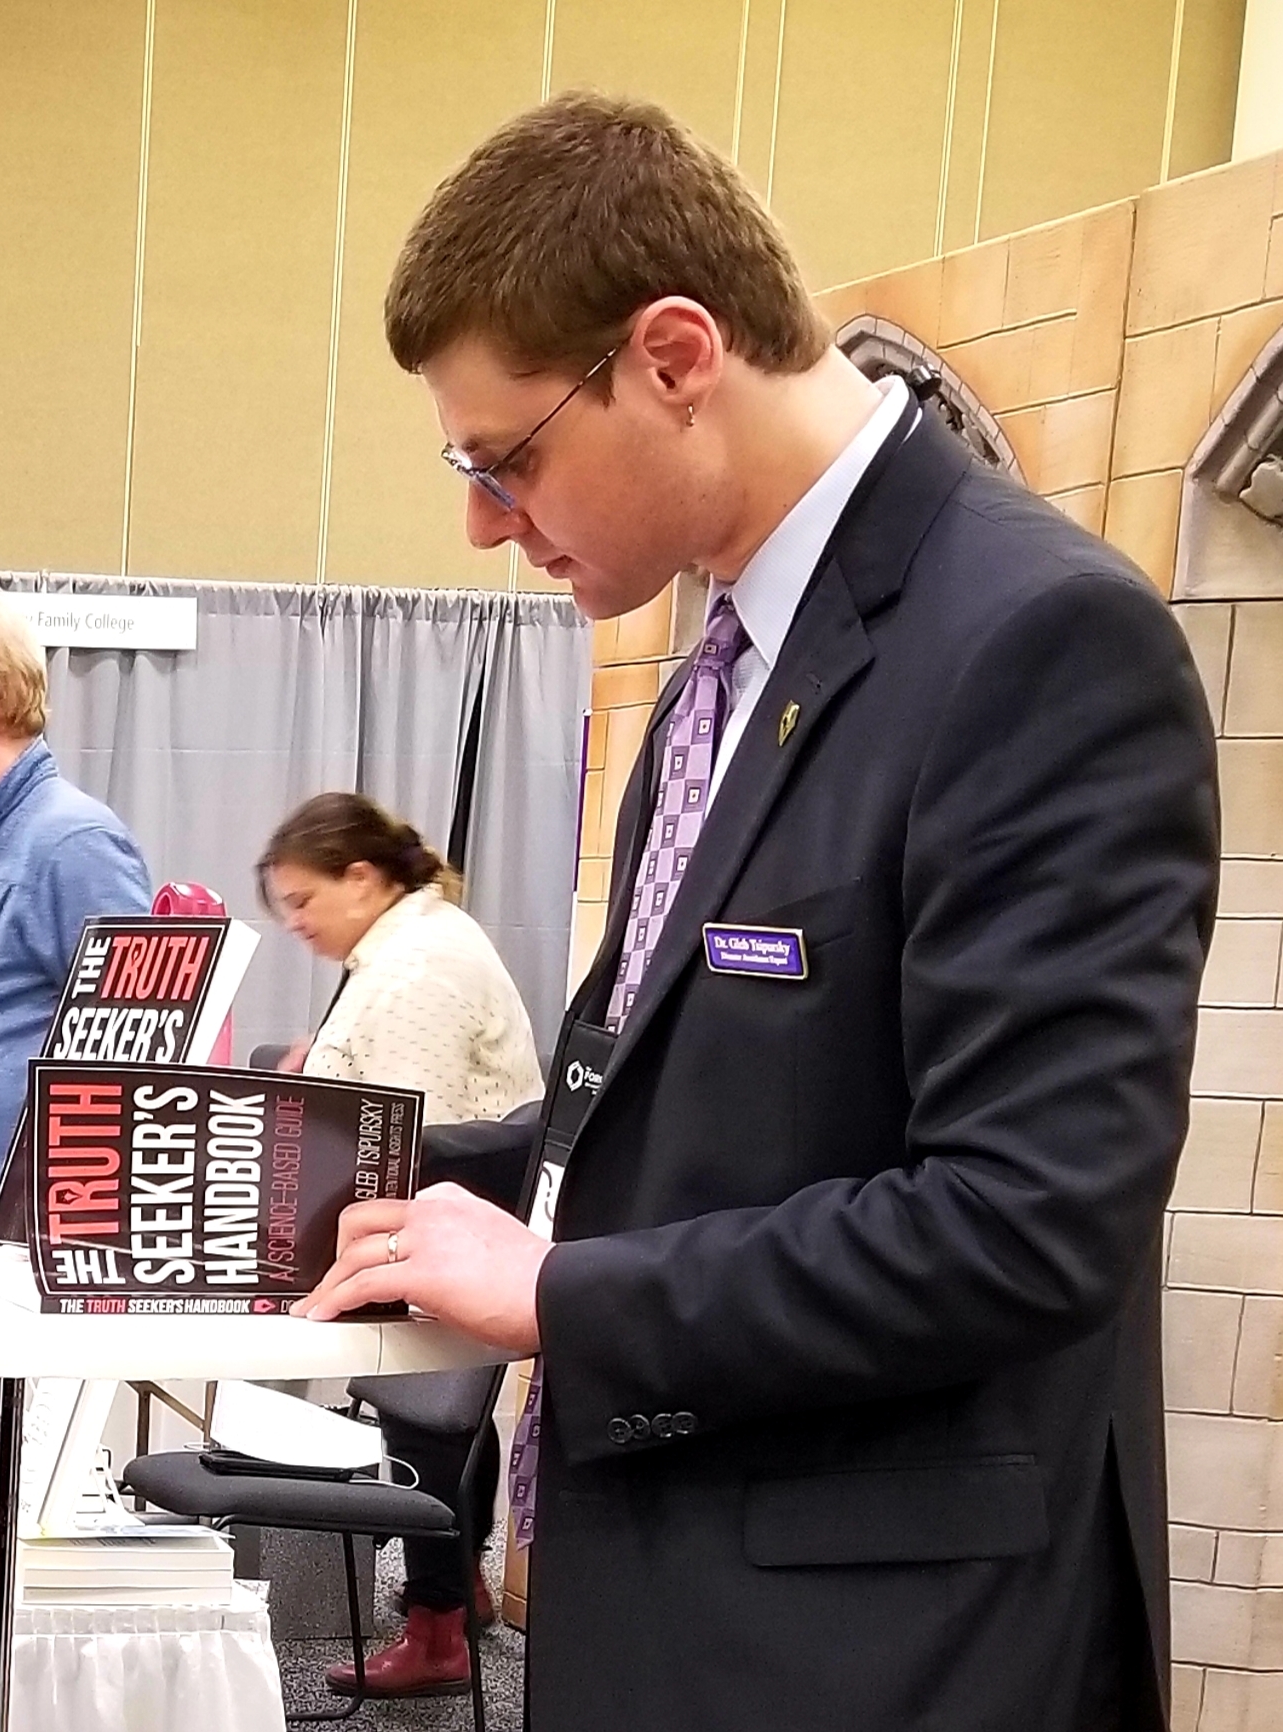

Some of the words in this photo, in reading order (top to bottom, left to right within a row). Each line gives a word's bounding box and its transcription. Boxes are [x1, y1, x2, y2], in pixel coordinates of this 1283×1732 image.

[38, 611, 80, 632] Family
[85, 613, 134, 634] College
[71, 937, 111, 999] THE
[100, 936, 209, 1001] TRUTH
[53, 1006, 184, 1063] SEEKER'S
[274, 1095, 305, 1138] GUIDE
[356, 1098, 384, 1166] TSIPURSKY
[390, 1102, 405, 1124] PRESS
[48, 1084, 122, 1245] TRUTH
[130, 1085, 199, 1285] SEEKER'S
[203, 1089, 266, 1285] HANDBOOK
[355, 1170, 379, 1200] GLEB
[267, 1143, 302, 1264] SCIENCE-BASED
[51, 1250, 126, 1285] THE
[59, 1299, 85, 1314] THE
[86, 1299, 126, 1314] TRUTH
[127, 1299, 184, 1314] SEEKER'S
[184, 1299, 250, 1314] HANDBOOK
